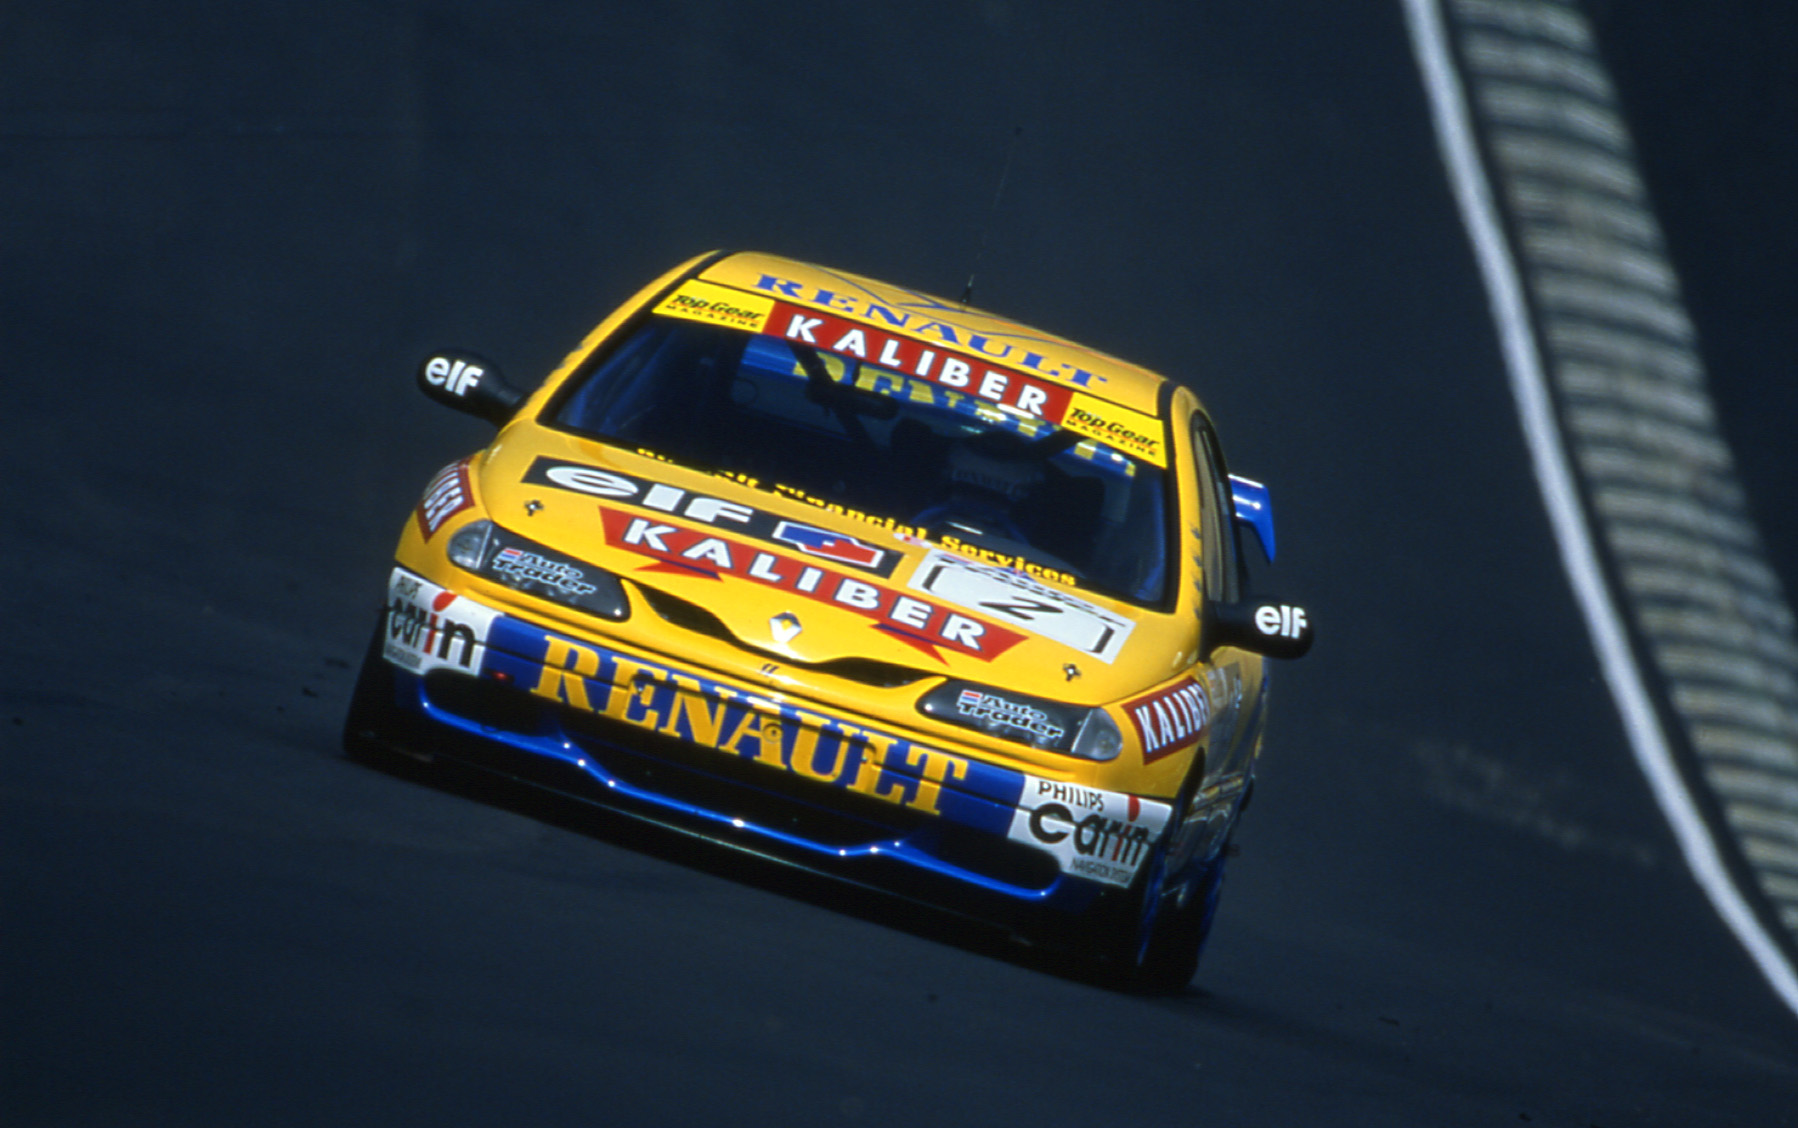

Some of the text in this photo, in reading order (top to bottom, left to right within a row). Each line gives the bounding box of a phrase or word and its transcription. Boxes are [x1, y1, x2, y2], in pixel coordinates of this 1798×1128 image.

[709, 301, 765, 319] Gear
[753, 273, 1108, 389] RENAULT
[425, 356, 484, 397] elf
[785, 313, 1048, 416] KALIBER
[1106, 421, 1161, 447] Gear
[545, 466, 754, 523] elf
[492, 558, 598, 596] Trader
[520, 551, 584, 581] Auto
[940, 534, 1076, 586] Services
[623, 517, 986, 651] KALIBER
[1254, 604, 1308, 640] elf
[529, 634, 969, 816] RENAULT
[956, 701, 1066, 739] Trader
[980, 694, 1048, 722] Auto
[1038, 780, 1104, 813] PHILIPS
